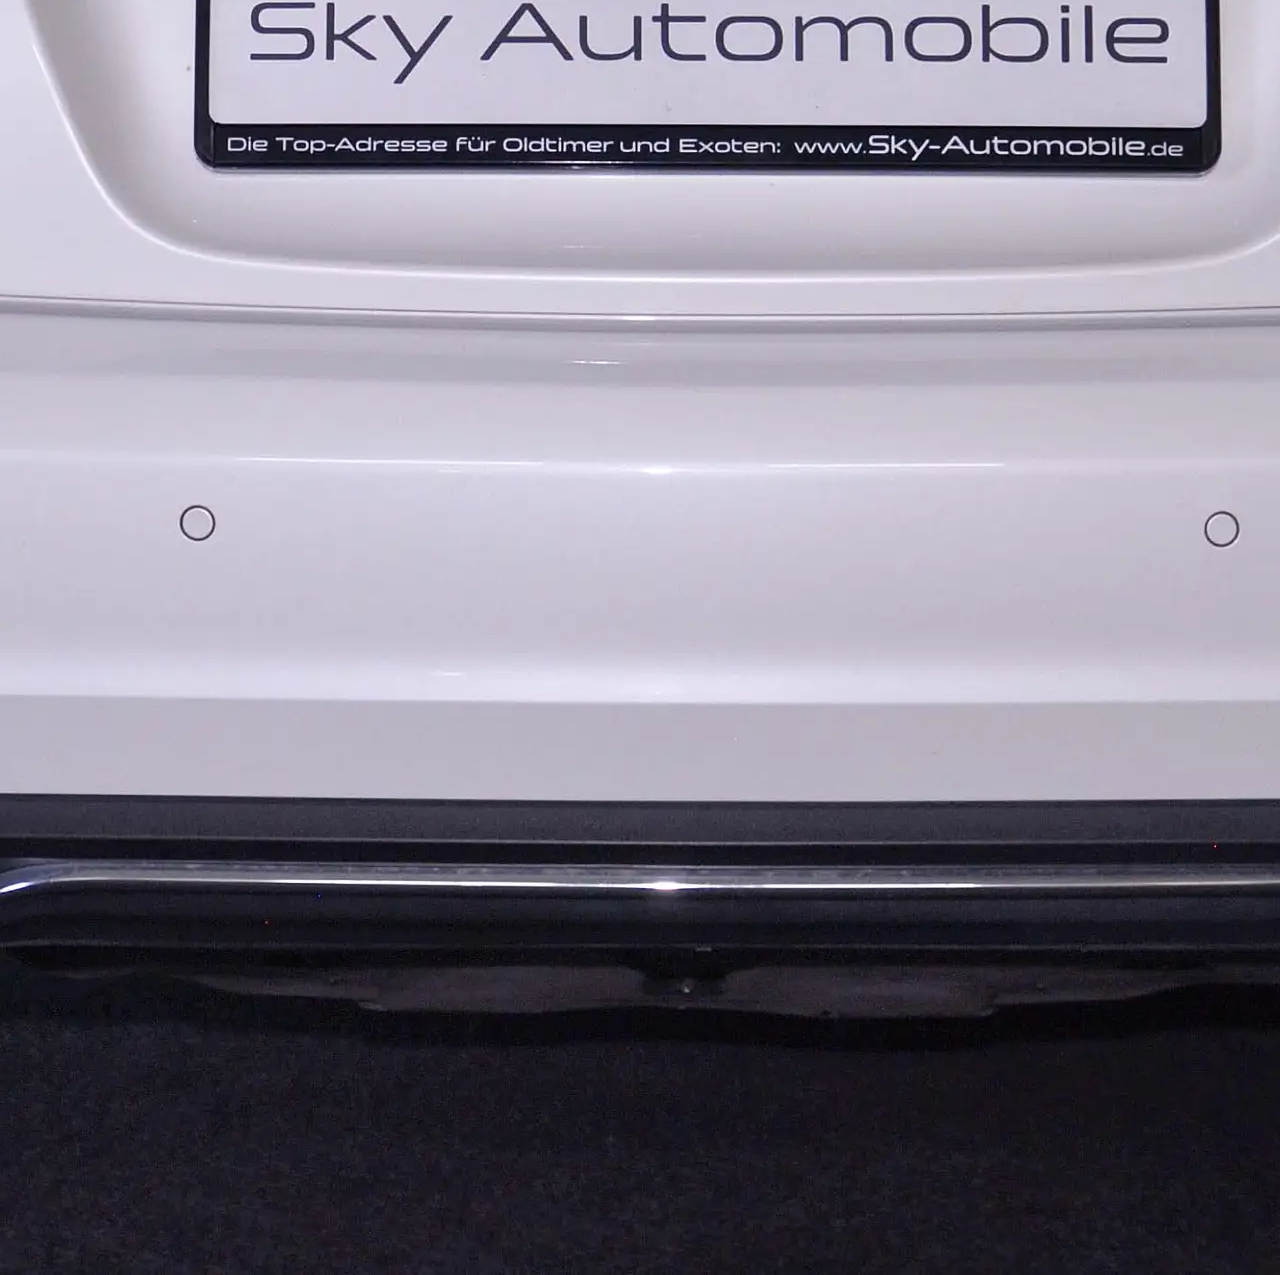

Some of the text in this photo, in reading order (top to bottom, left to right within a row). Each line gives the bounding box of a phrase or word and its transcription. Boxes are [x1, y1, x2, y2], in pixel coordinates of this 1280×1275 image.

[249, 1, 1170, 85] Sky Automobile
[227, 134, 1184, 162] Die Top-Adresse für Oldtimer und Exoten: www.Sky-Automobile.de
